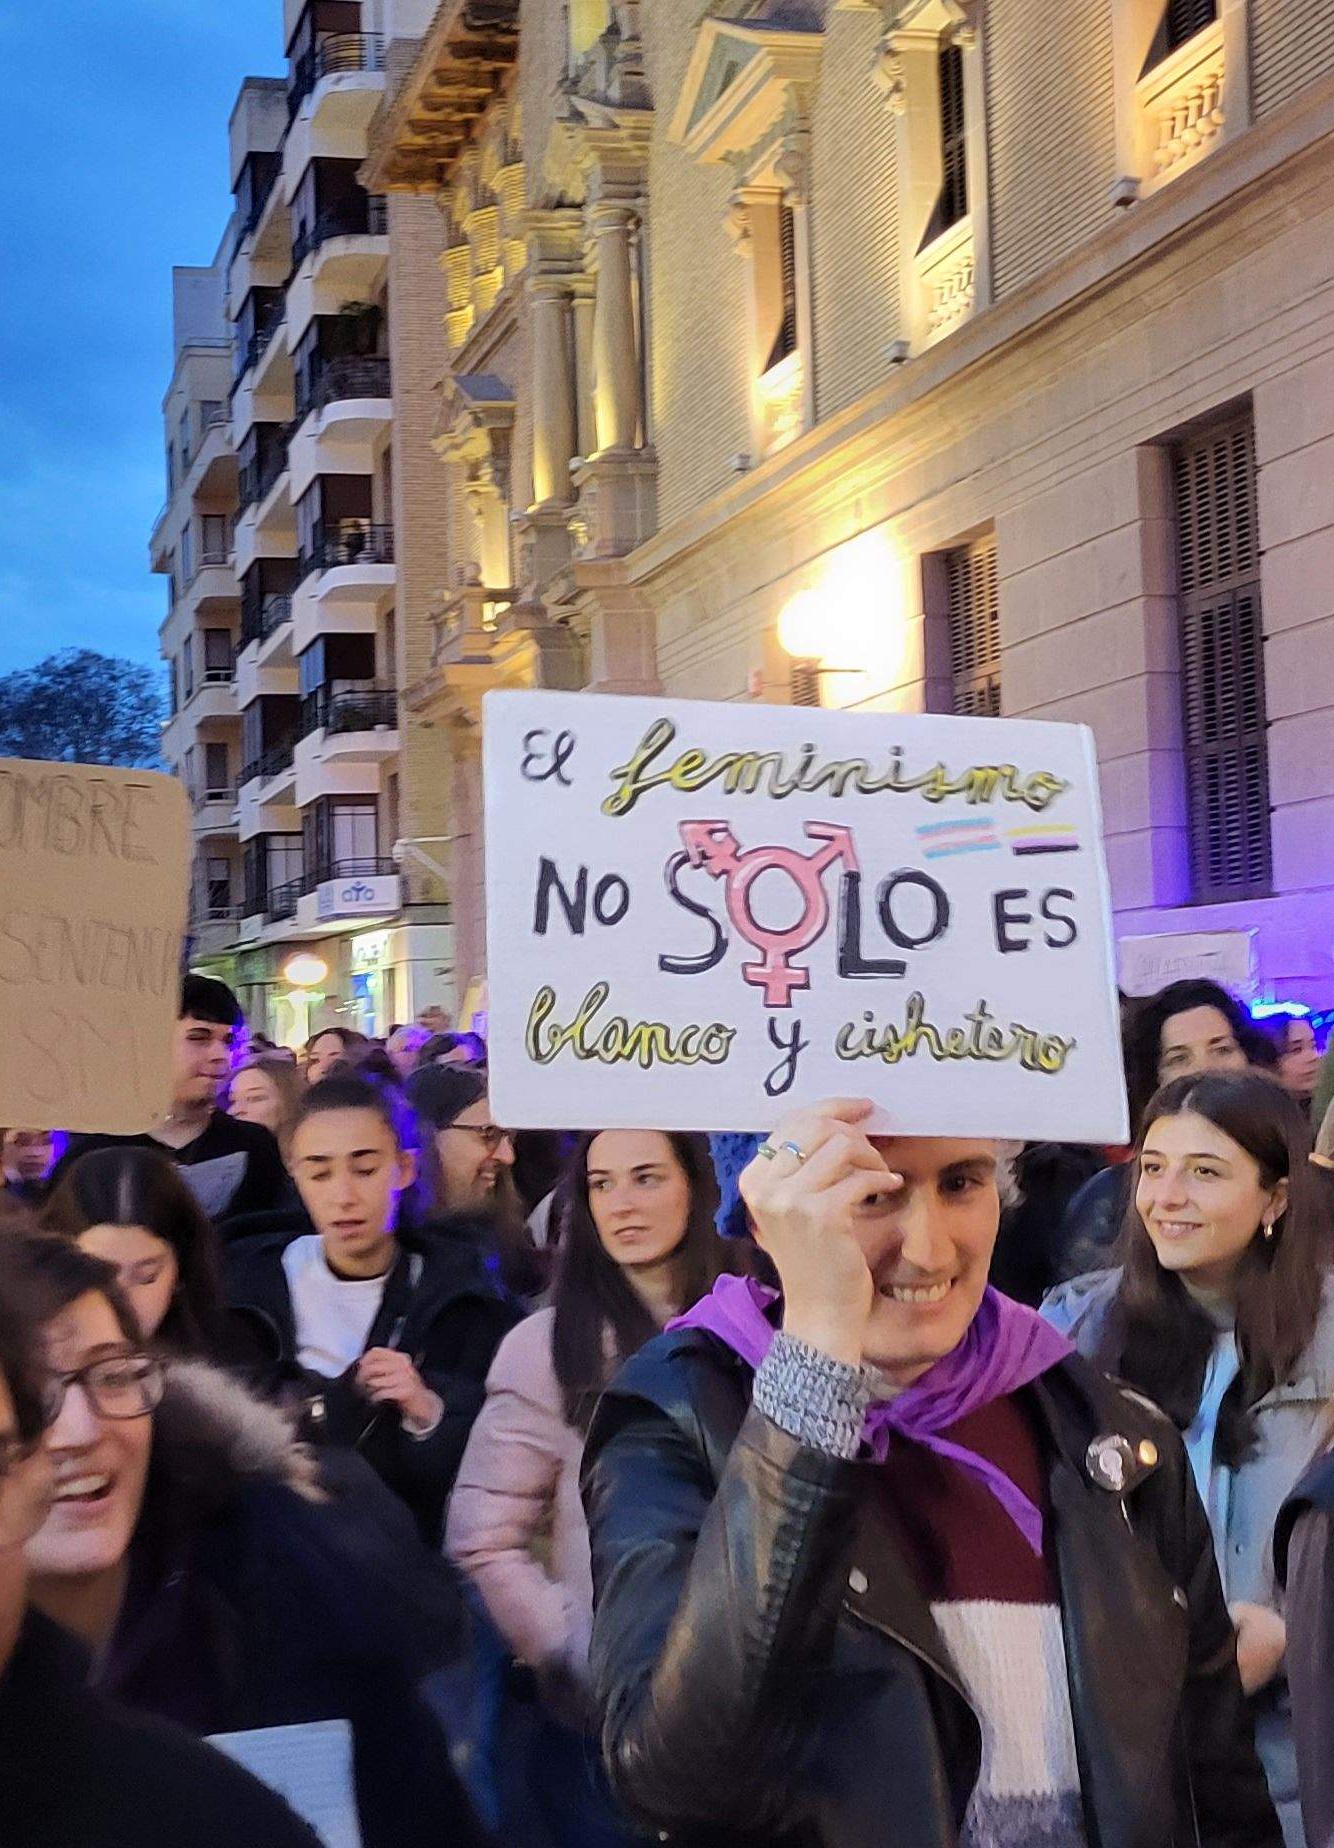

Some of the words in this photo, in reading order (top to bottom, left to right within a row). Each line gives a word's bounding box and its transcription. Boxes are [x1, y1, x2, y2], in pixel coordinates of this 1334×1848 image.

[520, 727, 578, 785] El
[601, 717, 1073, 818] feminismo
[532, 855, 631, 937] NO
[993, 887, 1078, 953] ES
[524, 981, 738, 1067] blanco
[762, 1015, 807, 1097] y
[835, 991, 1077, 1075] cishetero
